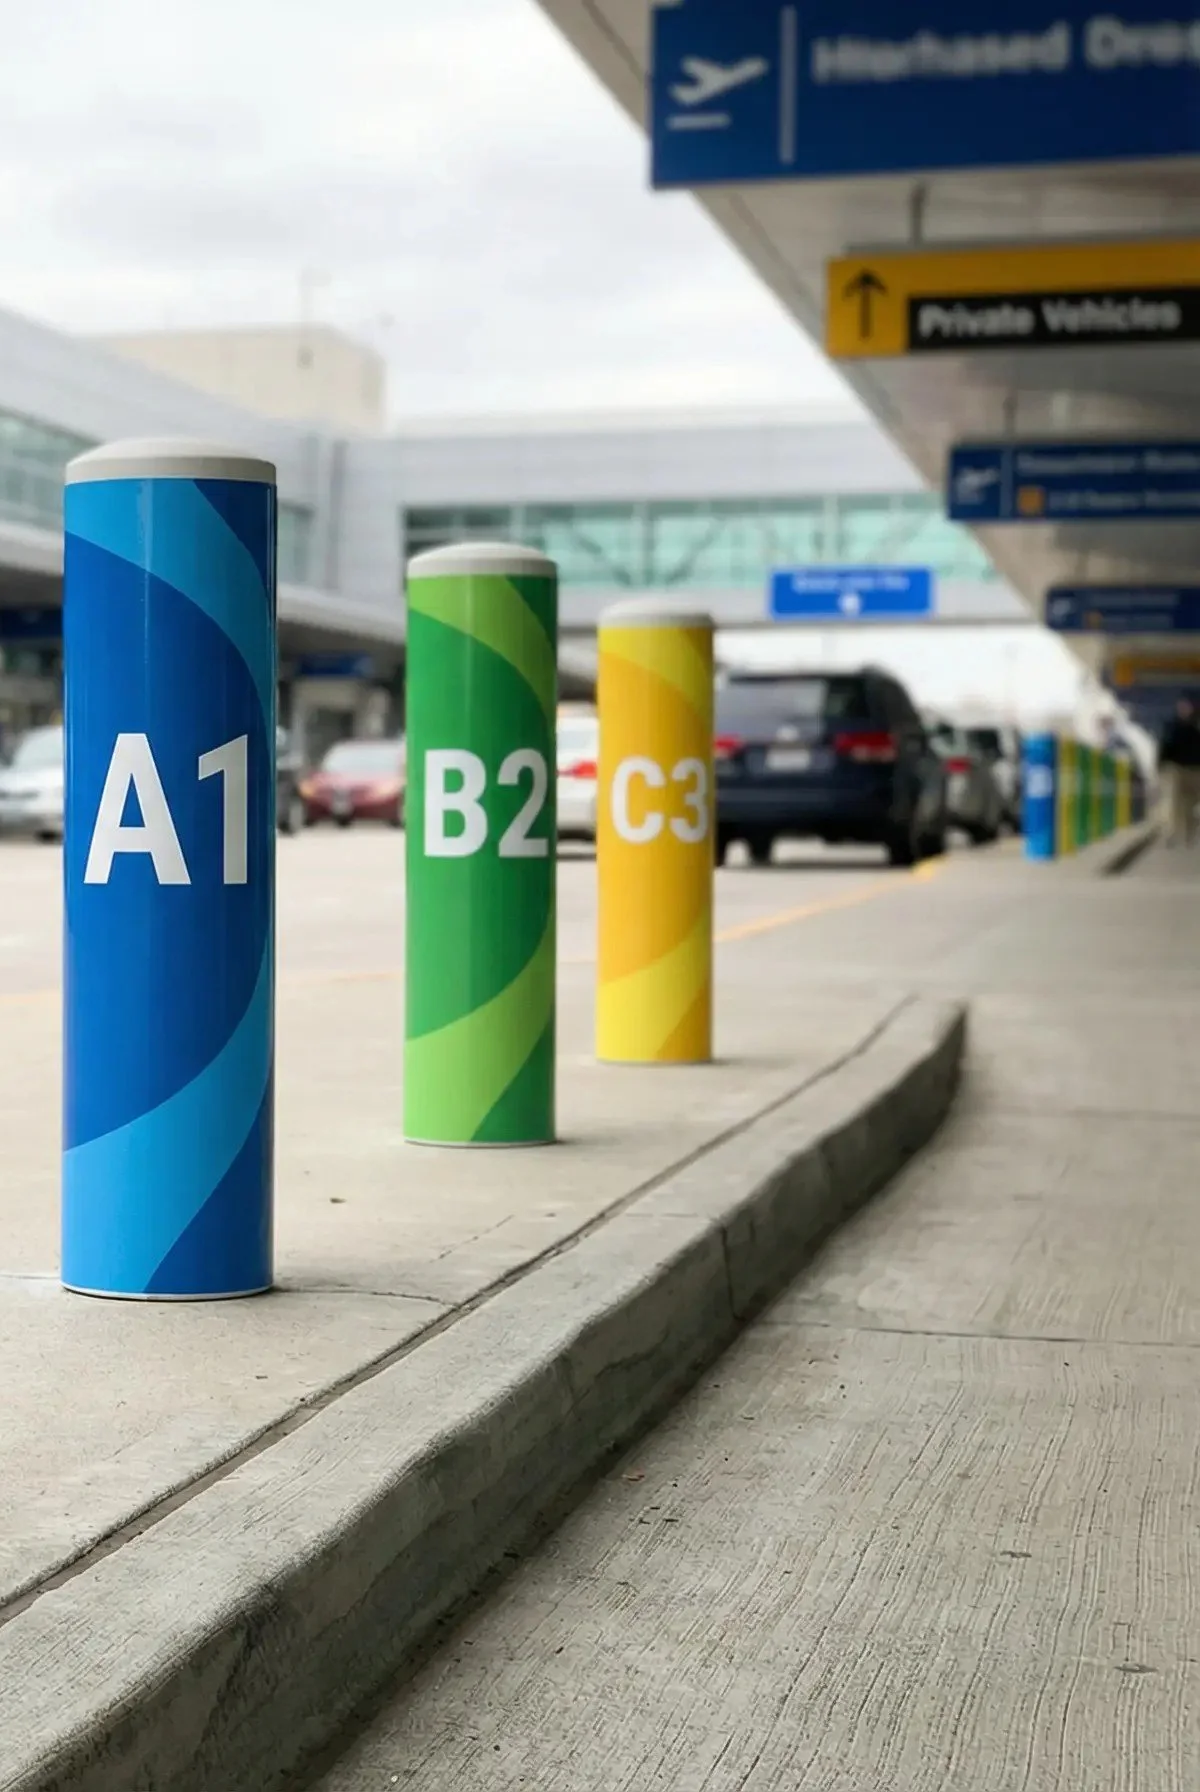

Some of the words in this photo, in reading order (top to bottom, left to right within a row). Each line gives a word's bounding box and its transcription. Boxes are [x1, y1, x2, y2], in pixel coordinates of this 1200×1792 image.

[918, 303, 1036, 339] Private
[1042, 297, 1180, 332] Vehicles
[84, 732, 249, 885] A1
[423, 748, 549, 858] B2
[610, 755, 709, 844] C3
